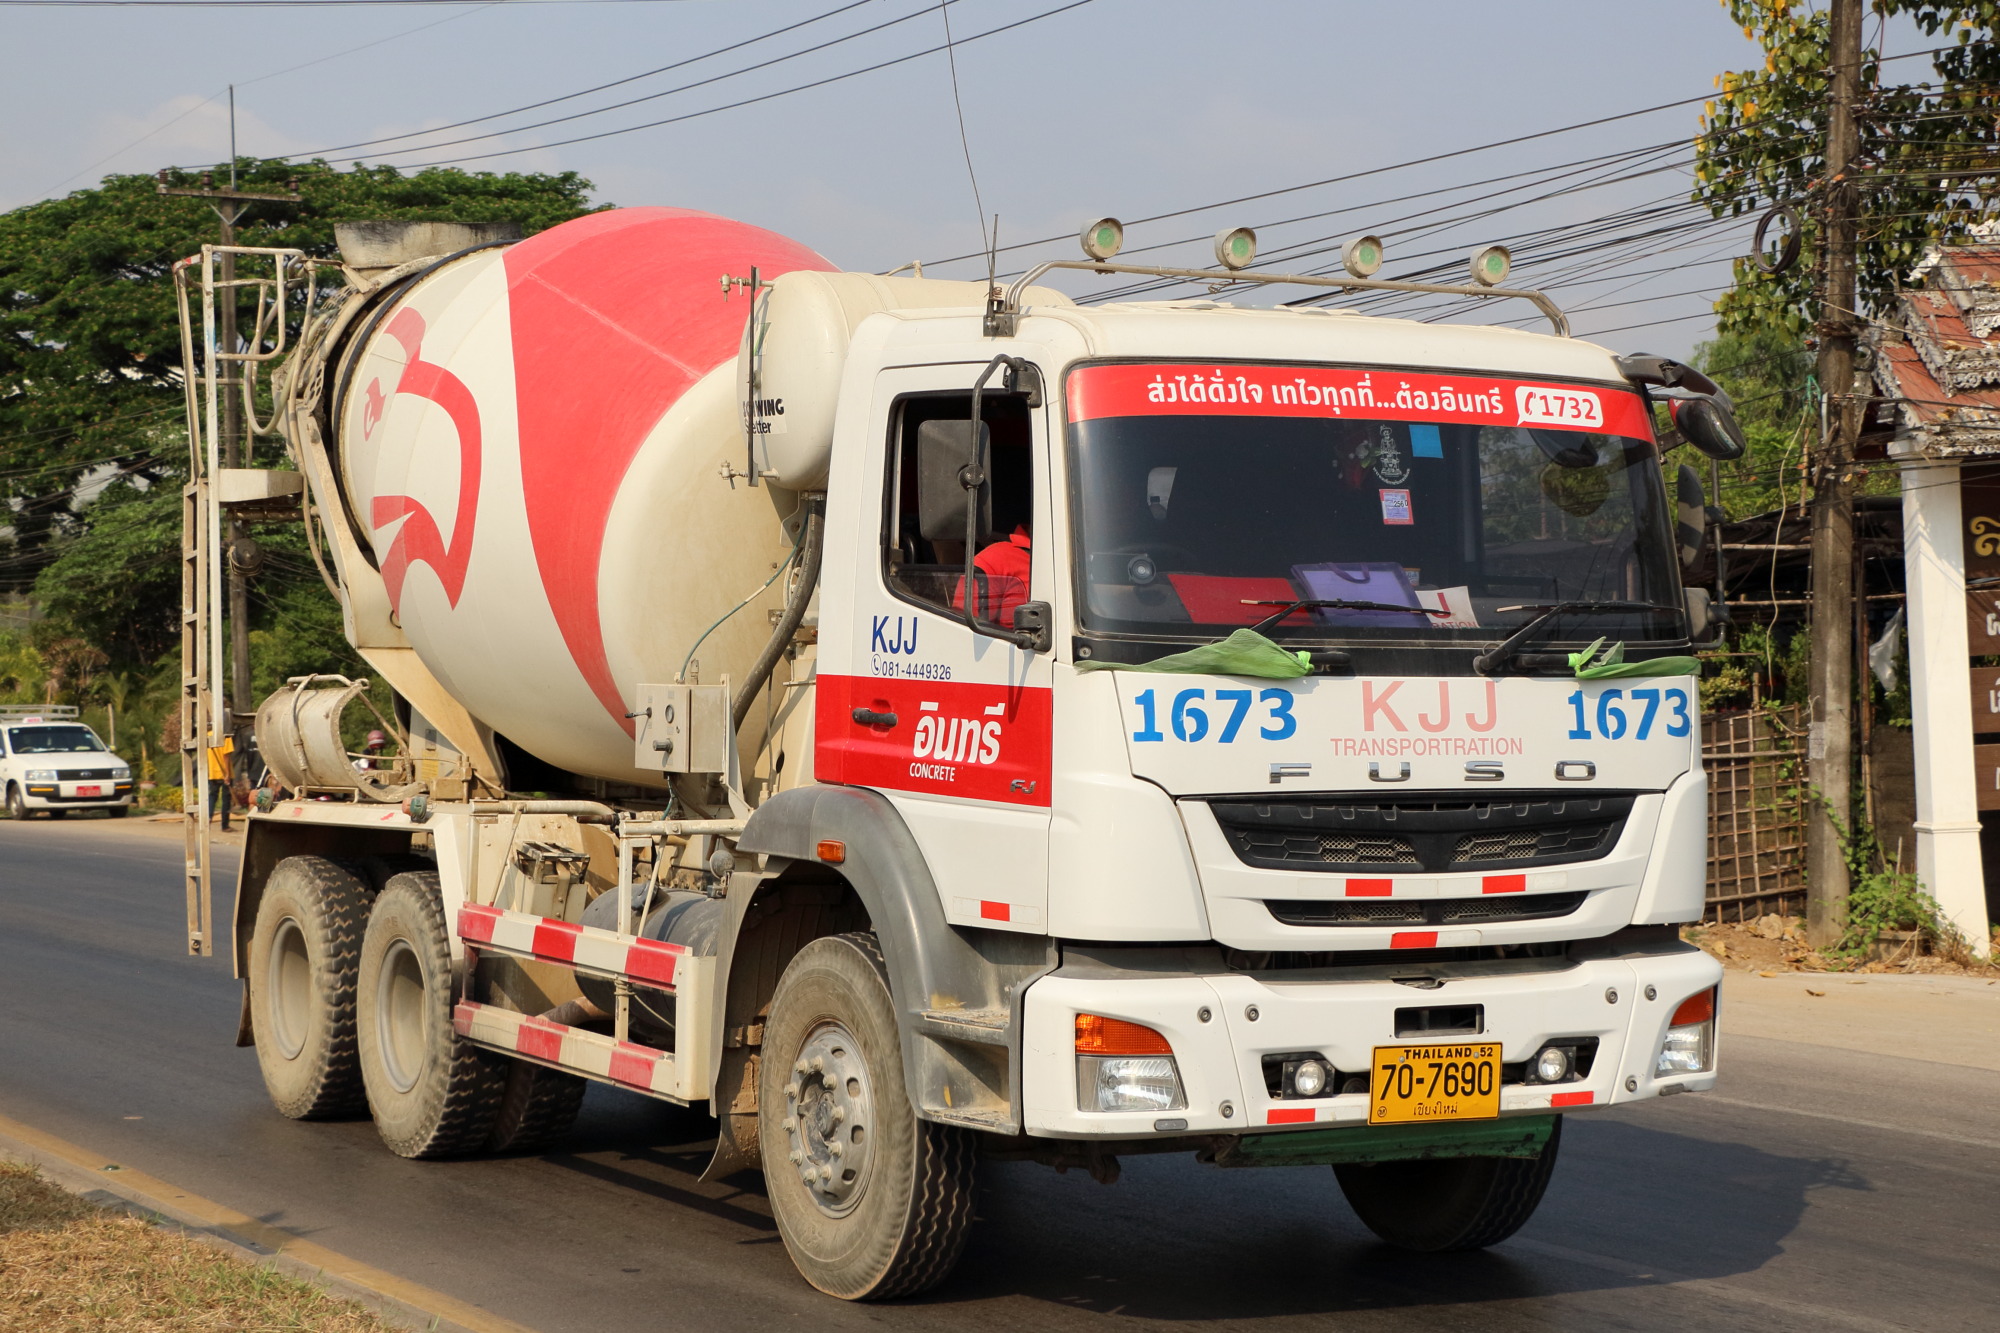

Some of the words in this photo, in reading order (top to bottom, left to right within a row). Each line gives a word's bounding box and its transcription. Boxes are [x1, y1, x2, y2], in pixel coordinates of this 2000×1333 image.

[1147, 369, 1263, 404] ส่งได้ดั่งใจ
[1539, 394, 1598, 421] 1732
[872, 615, 918, 655] KJJ
[882, 661, 951, 680] 081-4449326
[1133, 688, 1297, 743] 1673
[1362, 681, 1497, 732] KJJ
[1567, 688, 1691, 740] 1673
[913, 701, 1006, 765] อินทรี
[1330, 737, 1523, 756] TRANSPORTRATION
[909, 762, 956, 782] CONCRETE
[1269, 760, 1597, 784] FUSO
[1010, 779, 1036, 794] FJ
[1404, 1047, 1472, 1060] THAILAND
[1480, 1047, 1493, 1057] 52
[1380, 1061, 1493, 1101] 70-7690
[1413, 1101, 1458, 1116] เชียงใหม่
